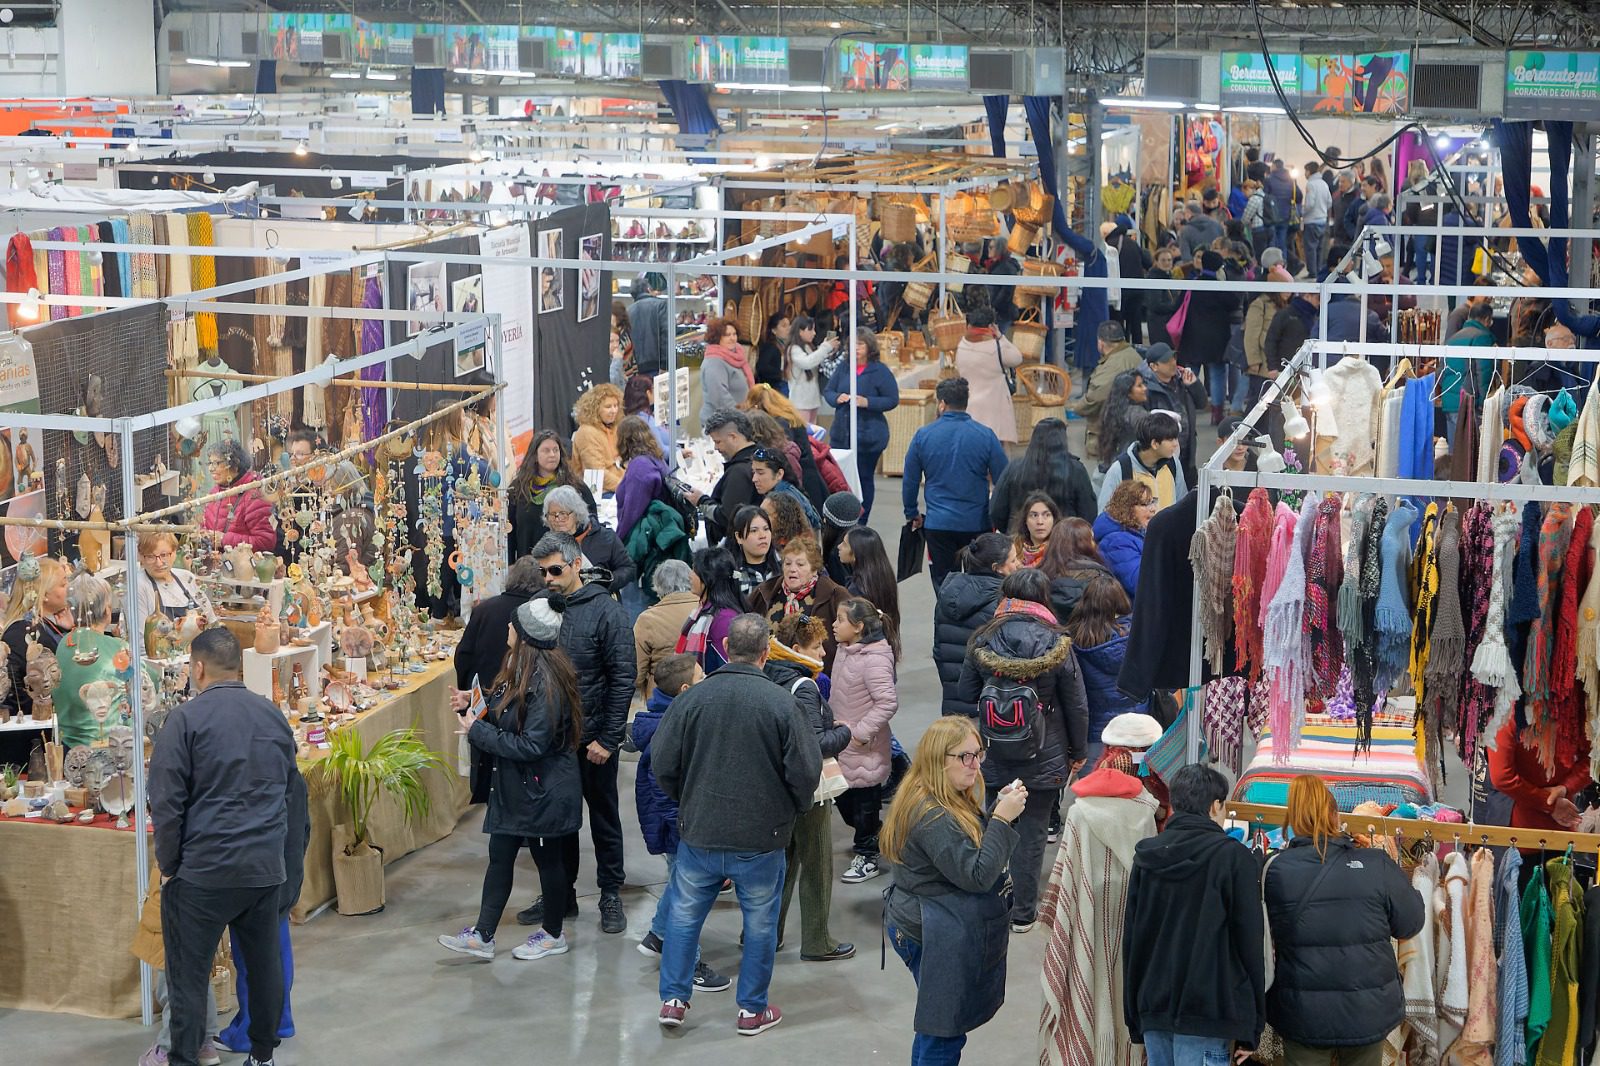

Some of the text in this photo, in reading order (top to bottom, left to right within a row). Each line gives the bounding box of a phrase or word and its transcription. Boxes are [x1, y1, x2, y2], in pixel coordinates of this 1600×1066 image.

[1230, 65, 1298, 85] Berazagui
[1514, 65, 1599, 89] Berazategui
[1231, 82, 1296, 95] CORAZÓN DE ZO SUR
[1515, 86, 1597, 98] CORAZÓN DE ZONA SUR
[501, 322, 523, 344] YERÍA
